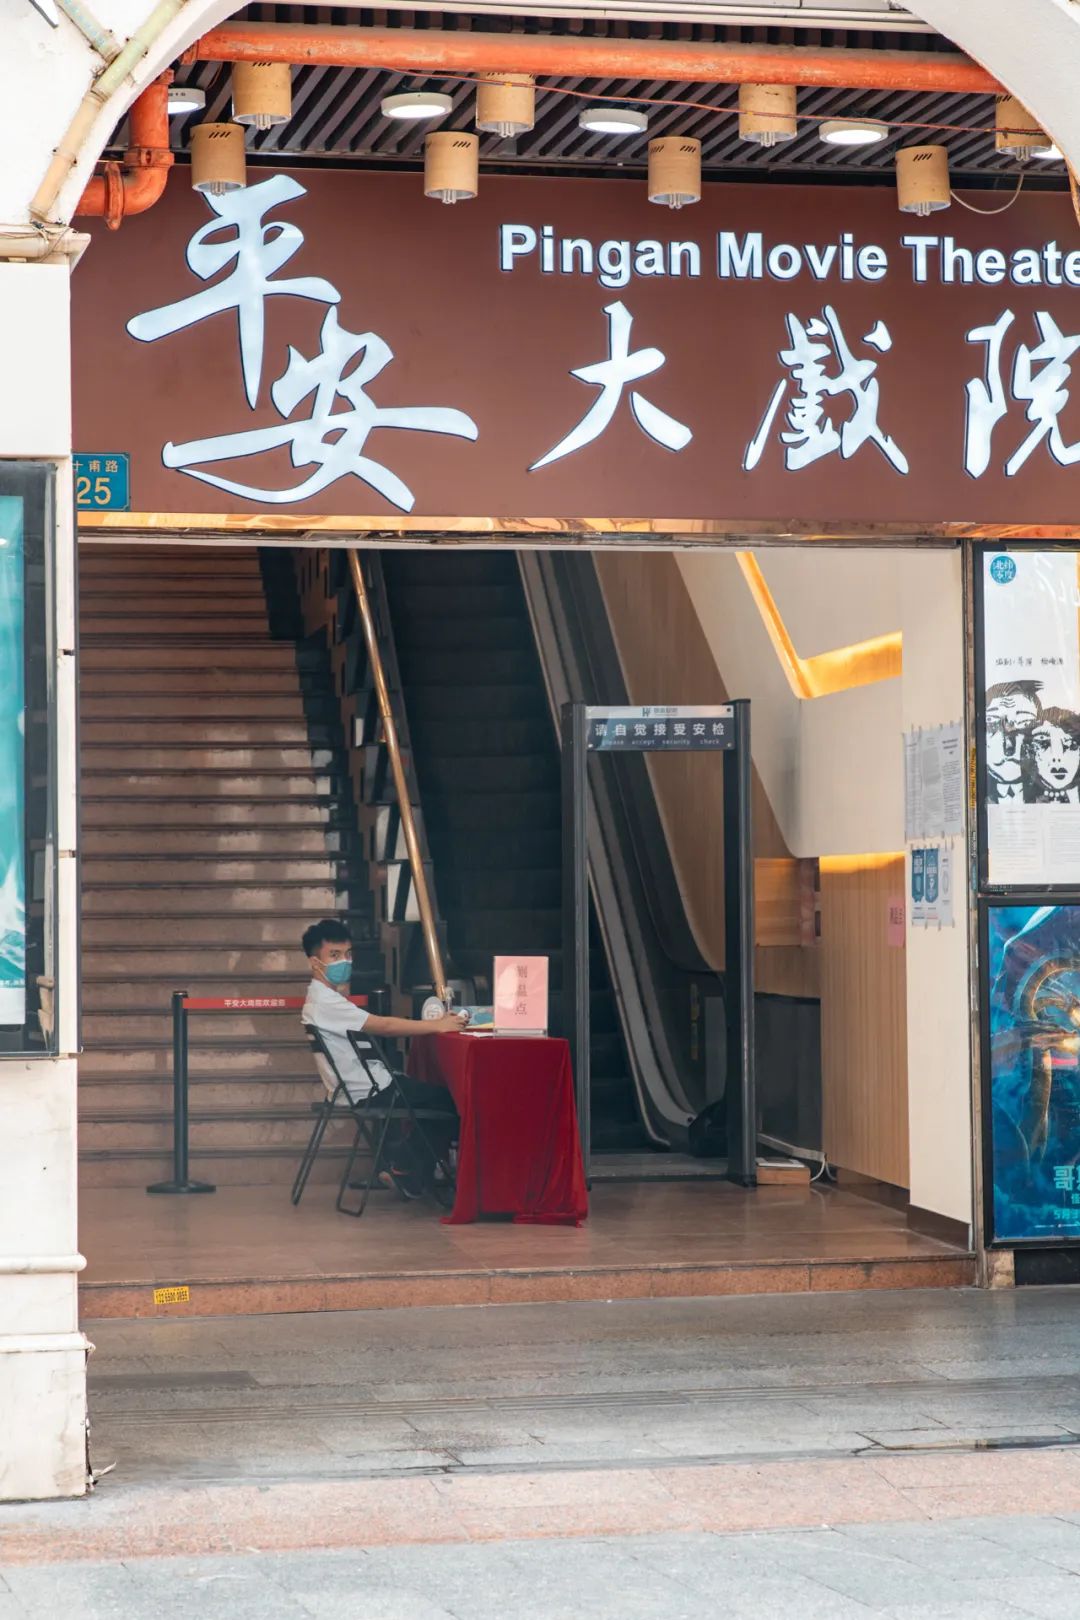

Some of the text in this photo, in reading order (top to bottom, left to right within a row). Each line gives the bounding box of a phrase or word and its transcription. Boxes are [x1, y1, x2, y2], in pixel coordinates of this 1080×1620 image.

[499, 223, 701, 289] Pingan
[717, 231, 889, 283] Movie
[77, 477, 111, 505] 25
[595, 723, 725, 736] 请自觉接受安检
